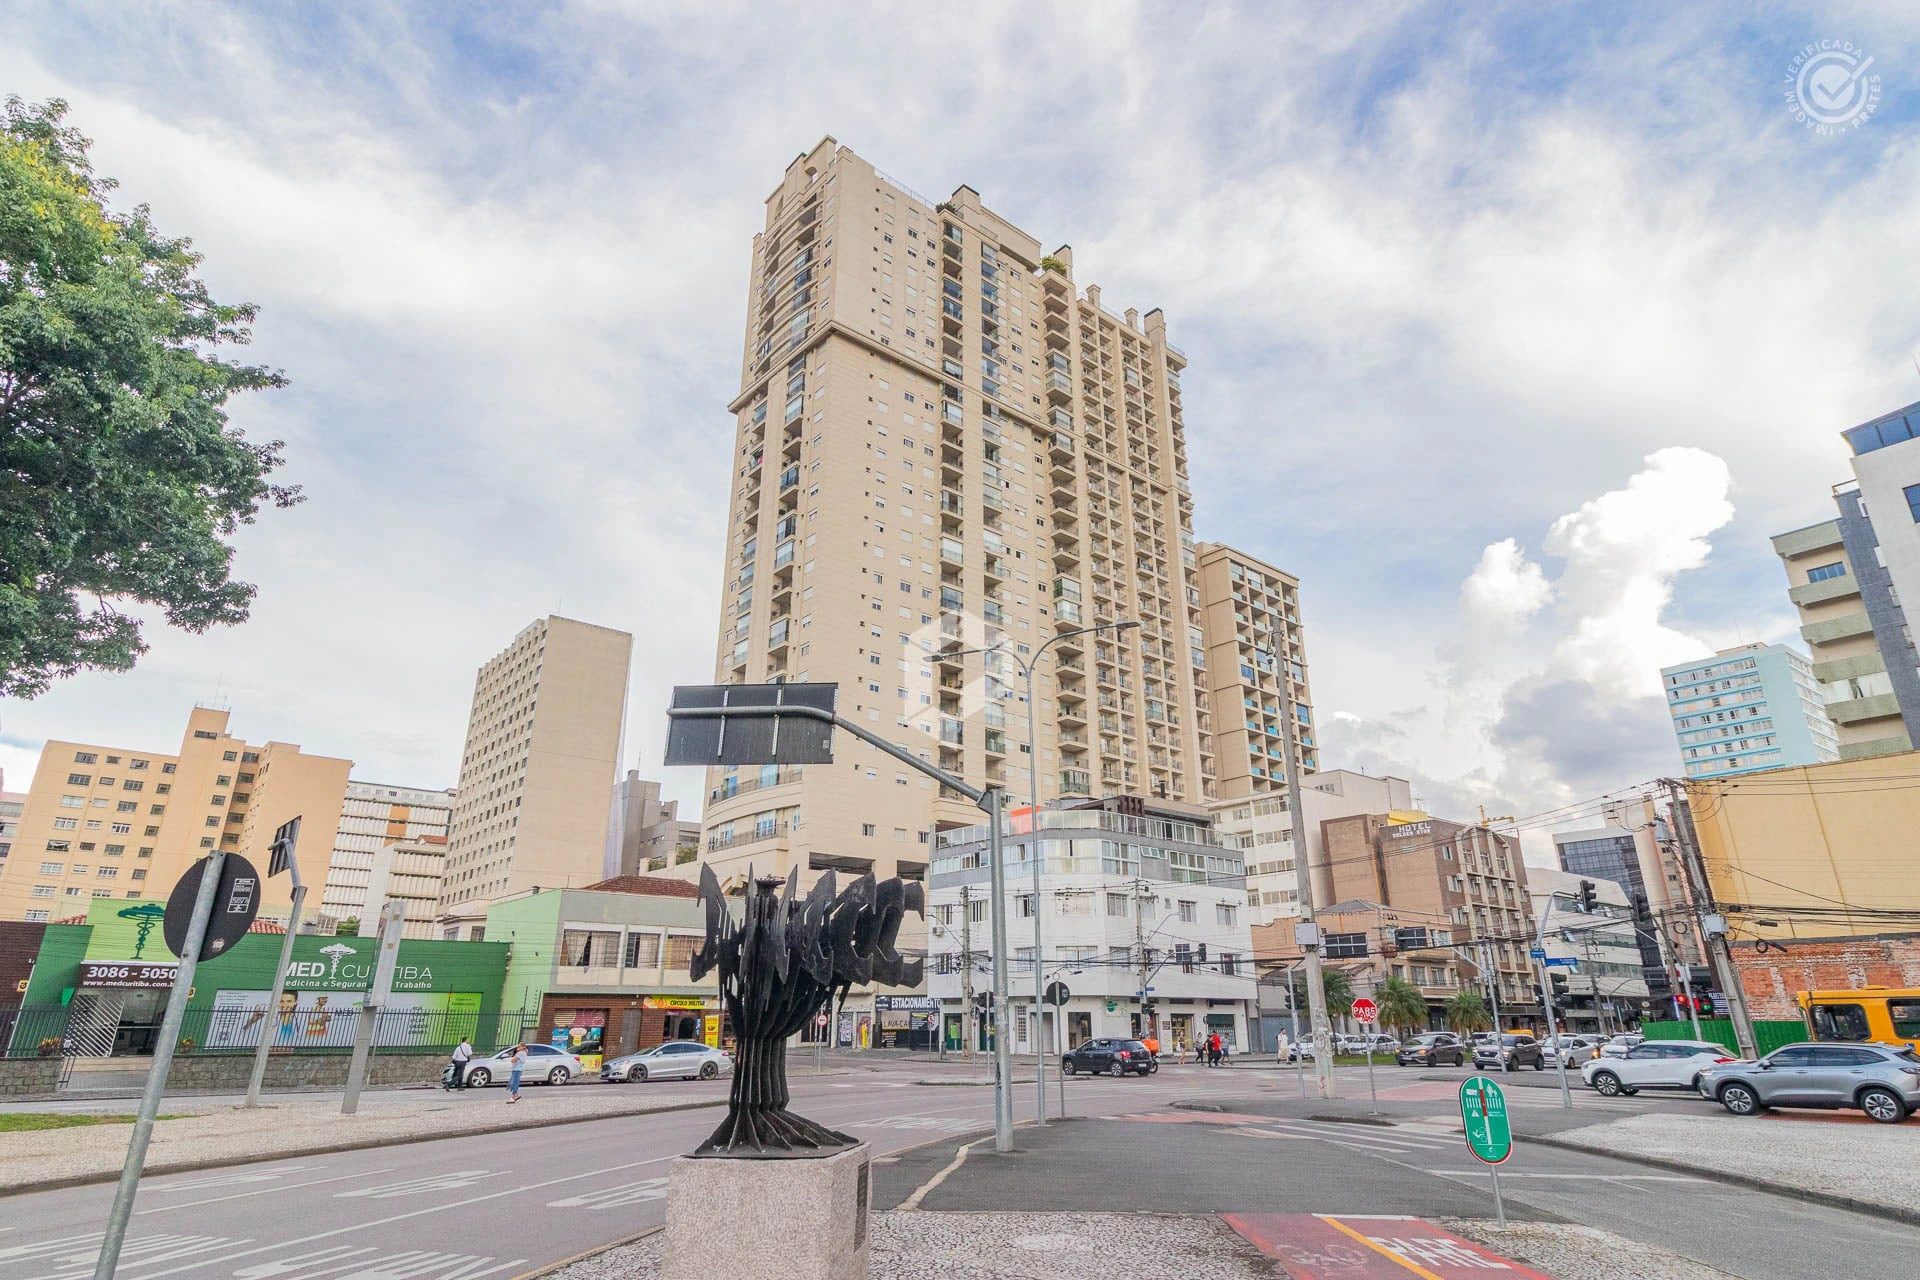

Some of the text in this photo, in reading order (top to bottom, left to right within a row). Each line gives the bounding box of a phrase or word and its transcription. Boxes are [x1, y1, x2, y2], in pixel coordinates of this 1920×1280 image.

[1398, 822, 1431, 833] HOTEL
[87, 966, 129, 978] 3086
[139, 968, 178, 979] 5050
[286, 962, 433, 980] MED CUIBA
[83, 980, 176, 988] www.medcuritiba.com.b
[285, 980, 320, 988] edicina
[331, 981, 368, 989] Seguran
[395, 981, 432, 989] Trabalho
[891, 996, 941, 1010] ESTACIONAMENTO
[1365, 1236, 1512, 1269] PARE
